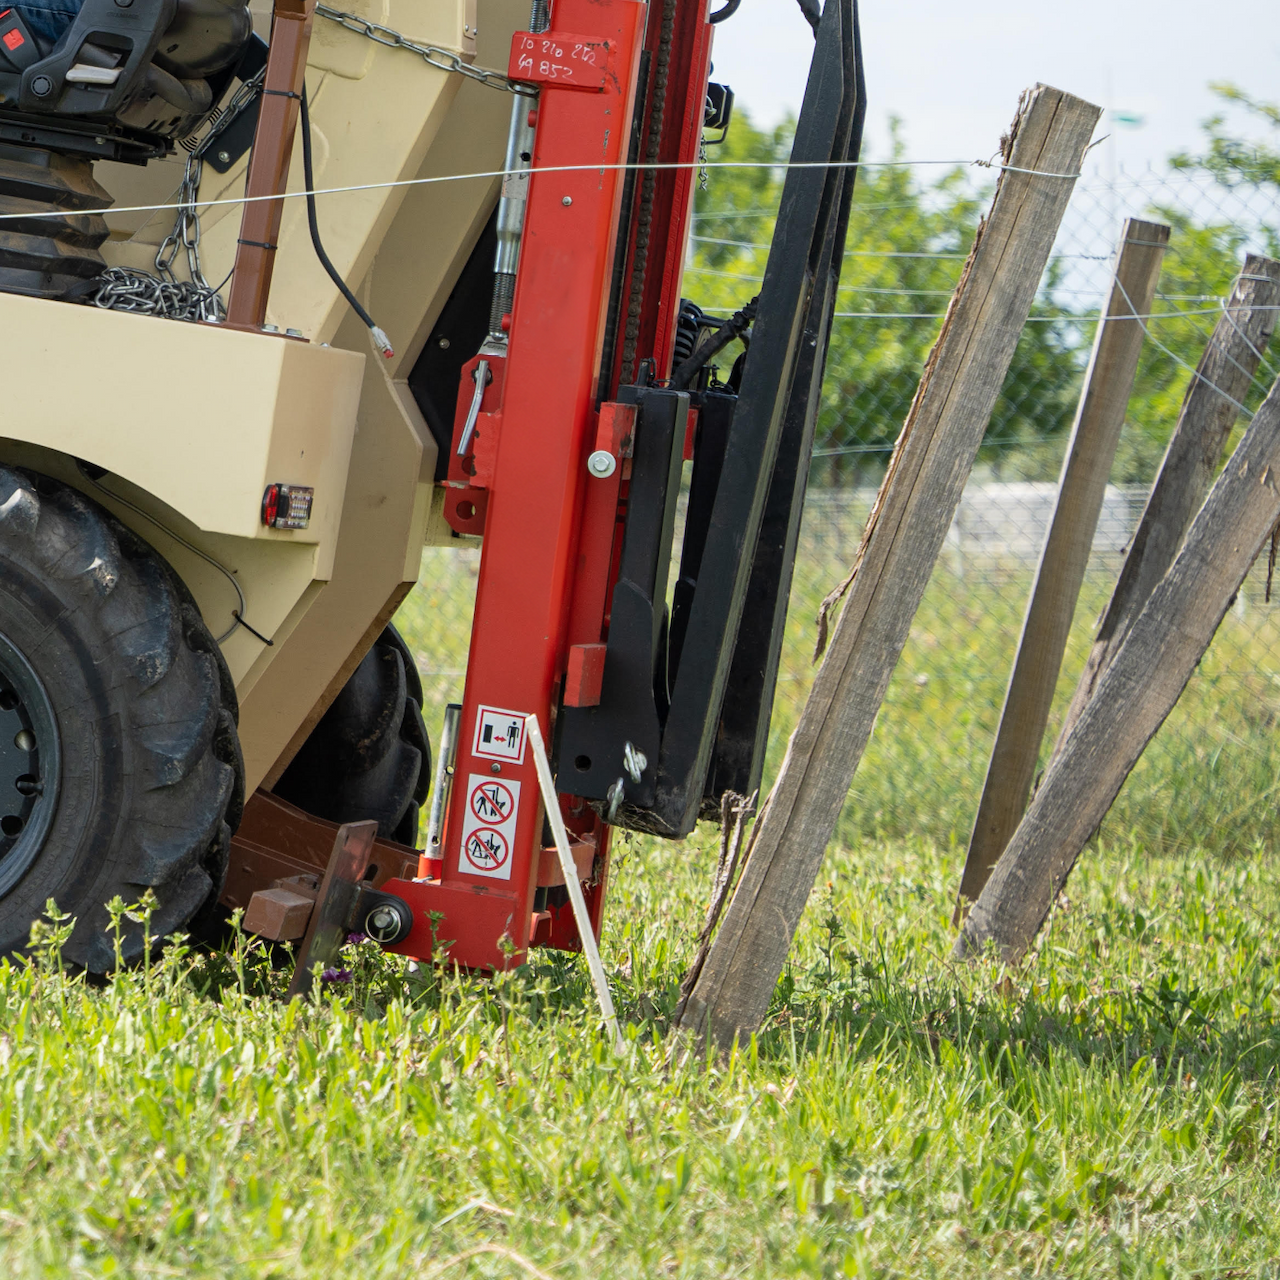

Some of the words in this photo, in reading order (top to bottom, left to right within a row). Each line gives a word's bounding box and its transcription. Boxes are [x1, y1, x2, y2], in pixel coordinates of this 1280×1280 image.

[521, 37, 534, 49] 10
[542, 40, 563, 57] 210
[539, 60, 578, 85] 852
